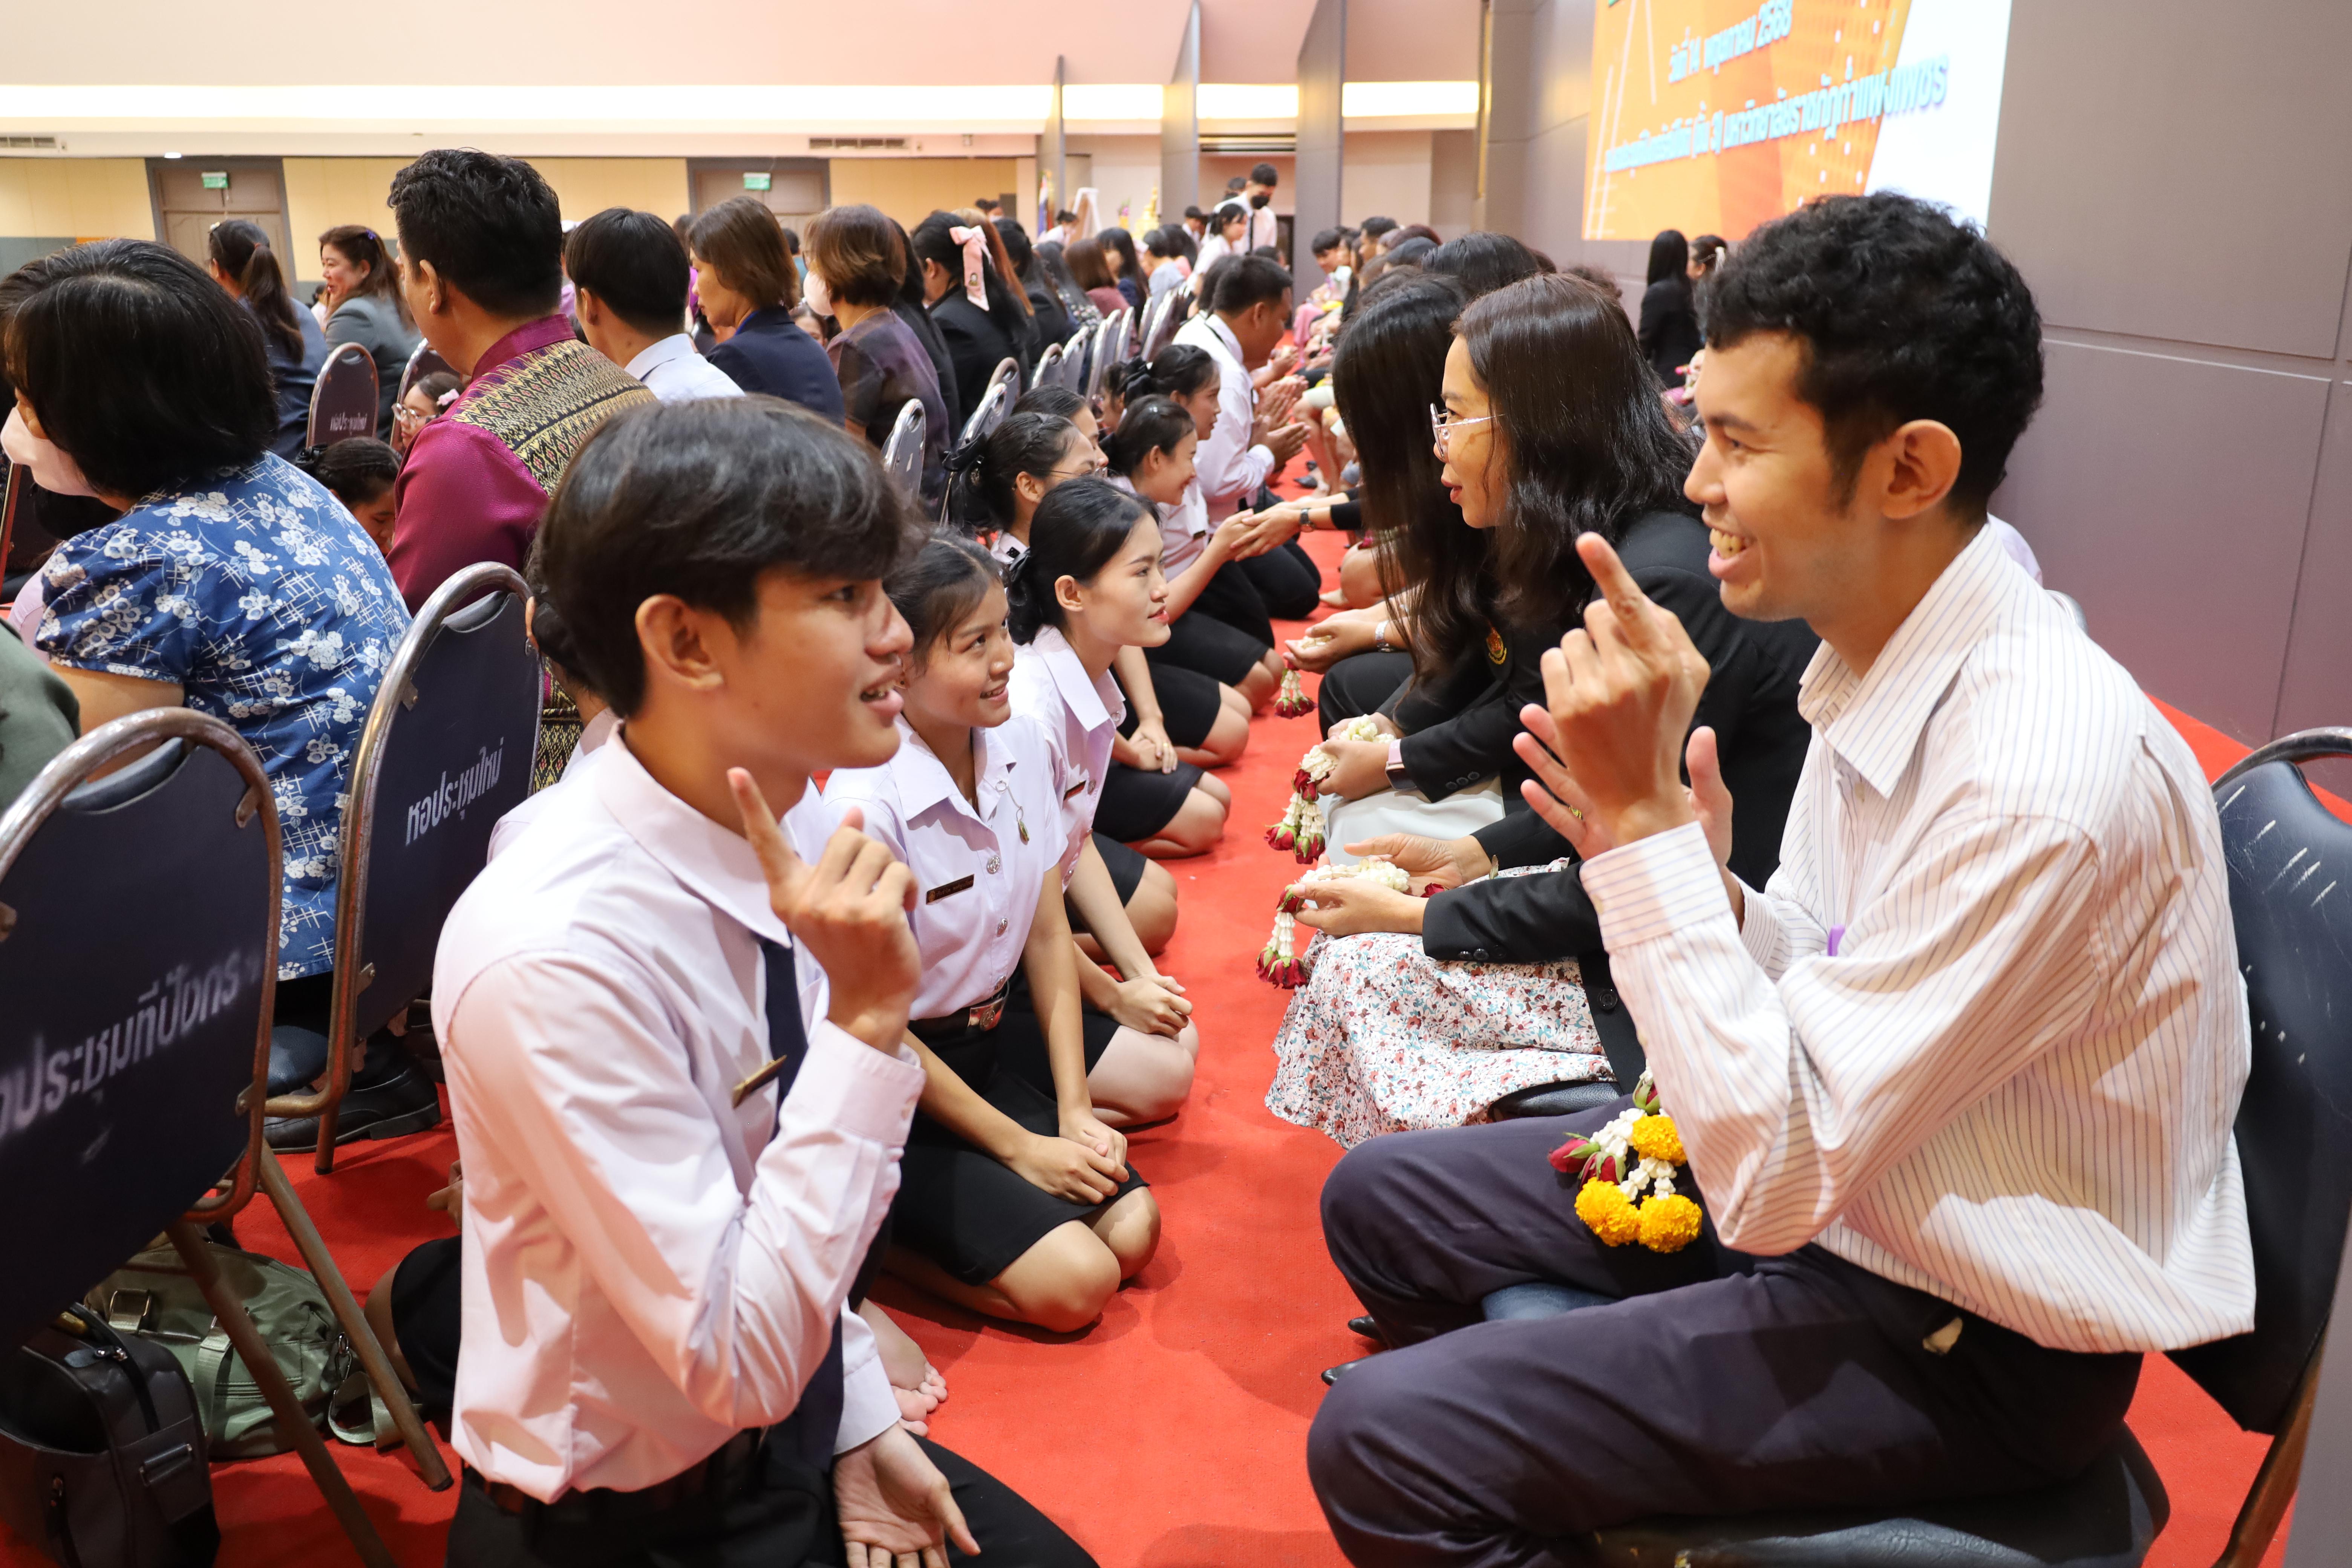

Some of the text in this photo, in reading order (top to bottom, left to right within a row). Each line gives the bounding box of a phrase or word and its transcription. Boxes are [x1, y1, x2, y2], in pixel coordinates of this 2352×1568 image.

[1756, 0, 1792, 48] 2568
[406, 737, 504, 846] หอประชุมใหม่
